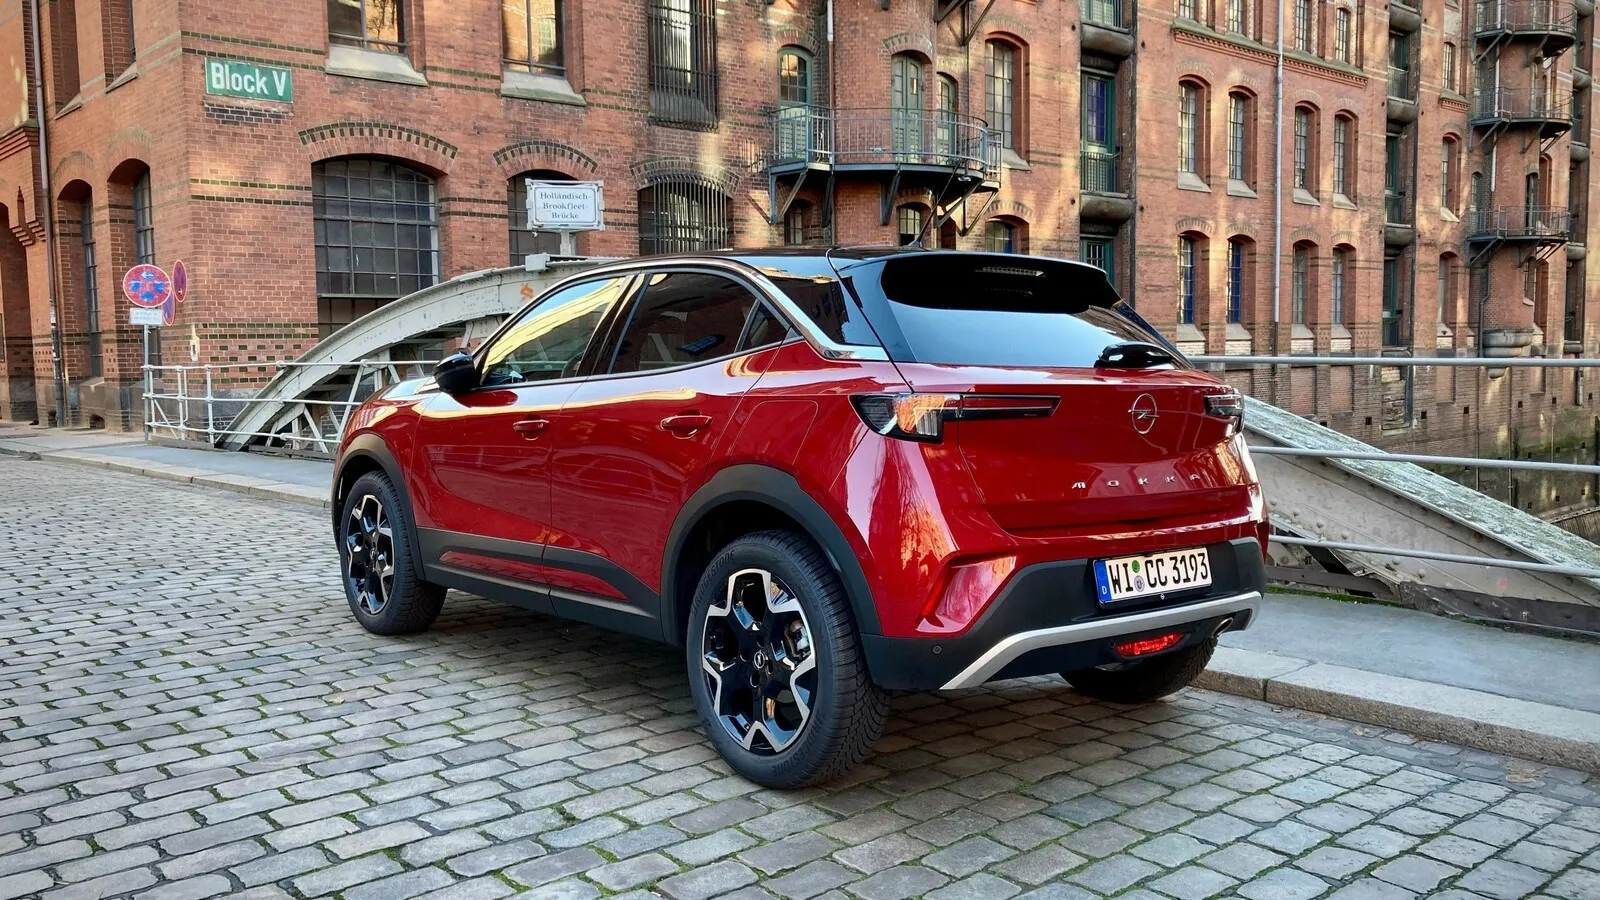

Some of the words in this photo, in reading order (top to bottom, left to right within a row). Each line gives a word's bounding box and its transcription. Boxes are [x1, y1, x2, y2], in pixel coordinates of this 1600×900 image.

[211, 62, 269, 95] Block
[272, 70, 287, 97] V
[1071, 473, 1201, 489] MOKKA
[1108, 563, 1134, 594] WI
[1144, 558, 1168, 589] CC
[1169, 552, 1209, 585] 3193
[1101, 585, 1108, 595] D
